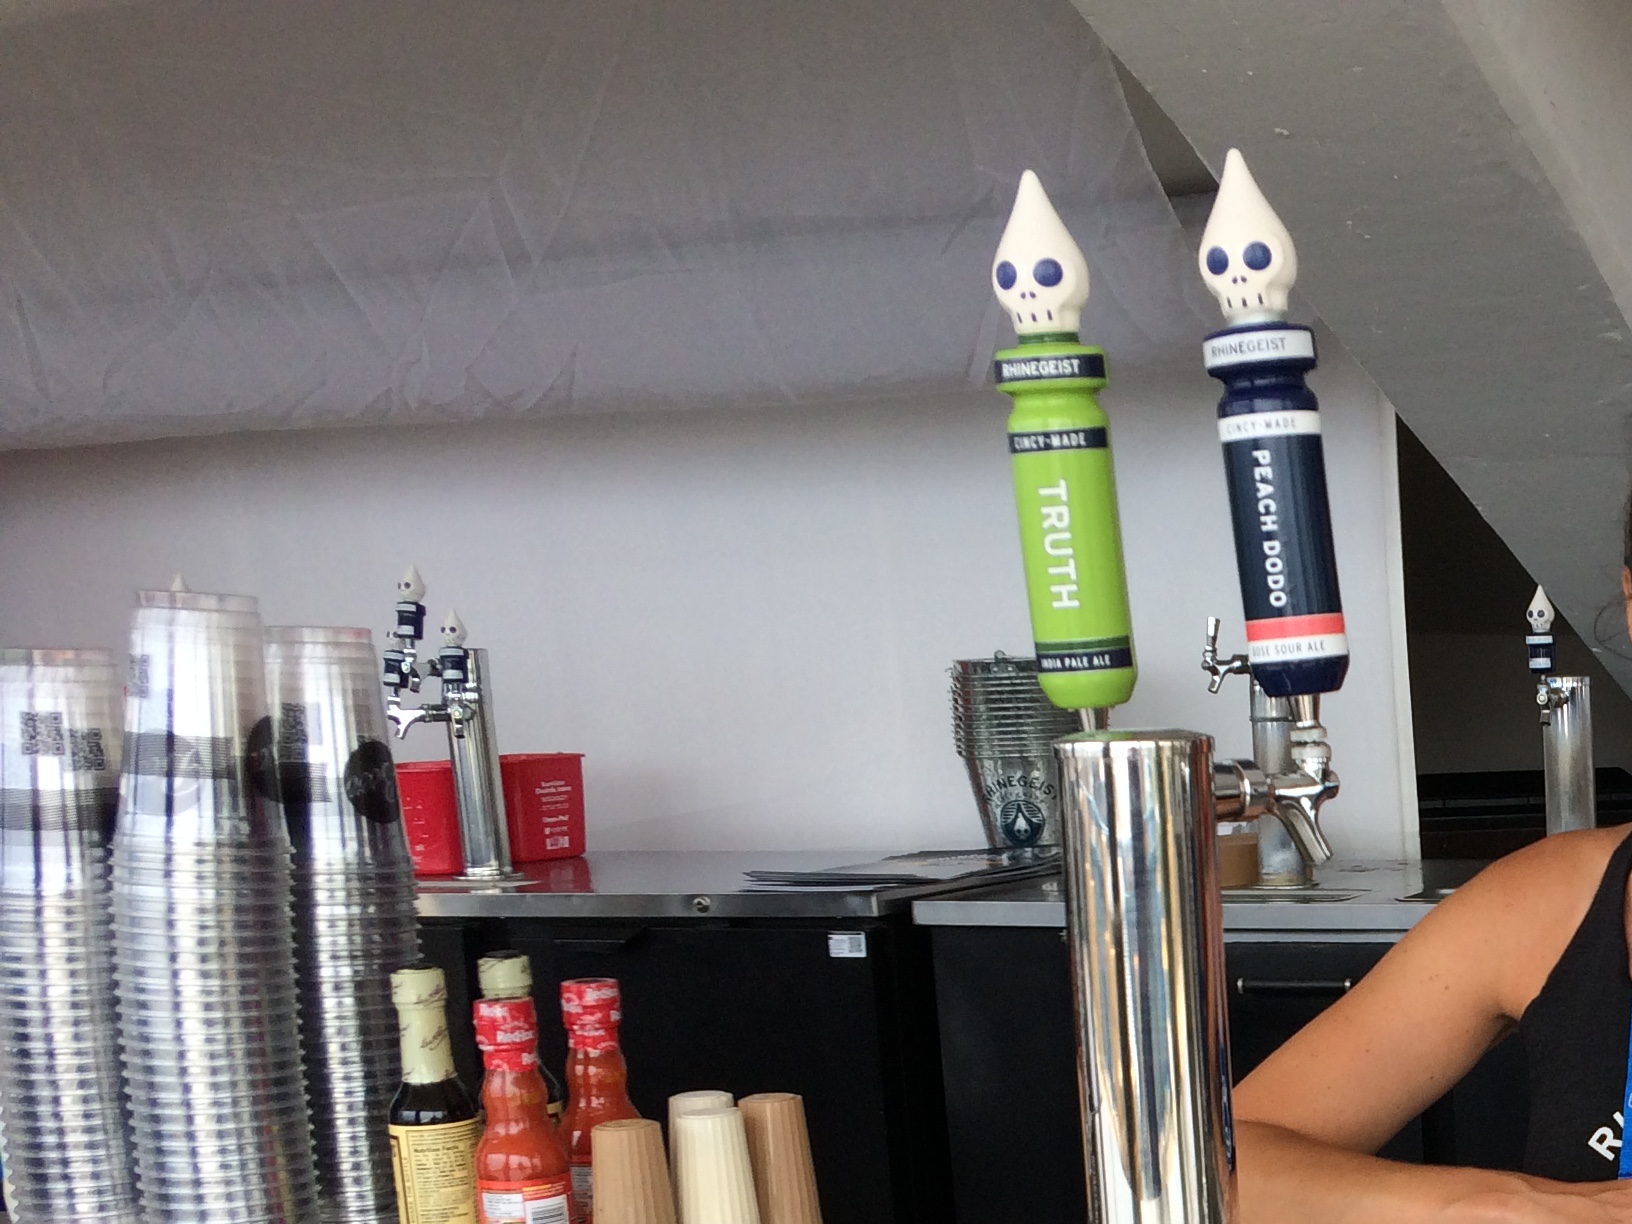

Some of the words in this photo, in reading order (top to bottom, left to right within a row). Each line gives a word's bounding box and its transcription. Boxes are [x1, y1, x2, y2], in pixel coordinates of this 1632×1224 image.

[1211, 336, 1287, 358] RHINEGEIST
[1002, 358, 1080, 377] RHINEGEIST
[1226, 415, 1297, 434] CINCY-MADE
[1013, 431, 1087, 450] CINCY-MADE
[1252, 449, 1278, 533] PEACH
[1037, 478, 1081, 609] TRUTH
[1263, 540, 1288, 608] DODO
[1274, 642, 1302, 655] SOUR
[1308, 639, 1325, 651] ALE
[1064, 655, 1089, 668] PALE
[1093, 653, 1111, 667] ALE
